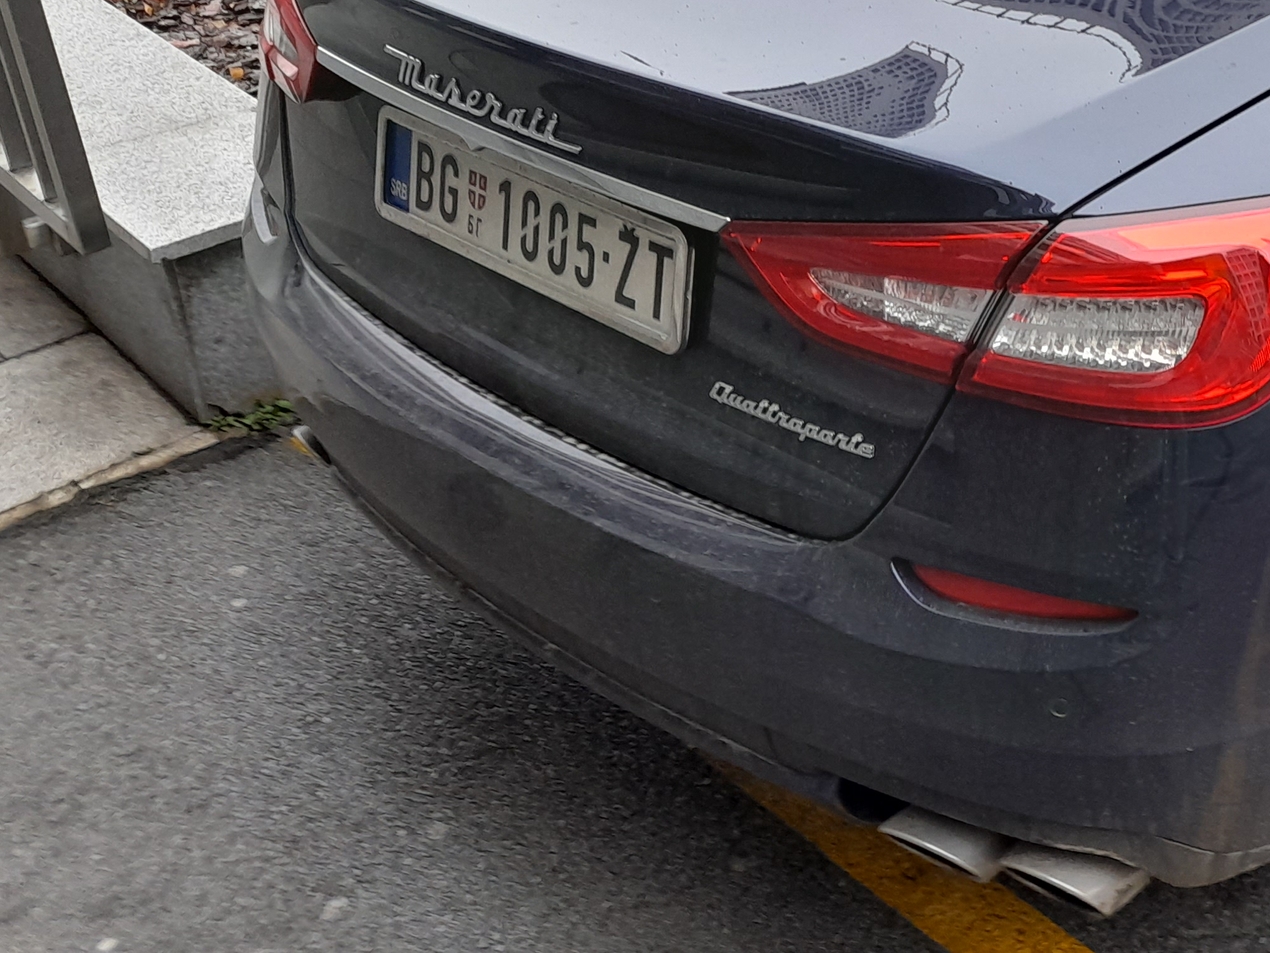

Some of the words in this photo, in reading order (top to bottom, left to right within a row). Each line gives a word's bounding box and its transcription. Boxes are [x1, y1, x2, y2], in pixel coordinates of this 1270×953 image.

[384, 44, 582, 154] Maserati
[390, 177, 408, 201] SRB
[415, 140, 459, 224] BG
[709, 381, 876, 460] Quattroporte
